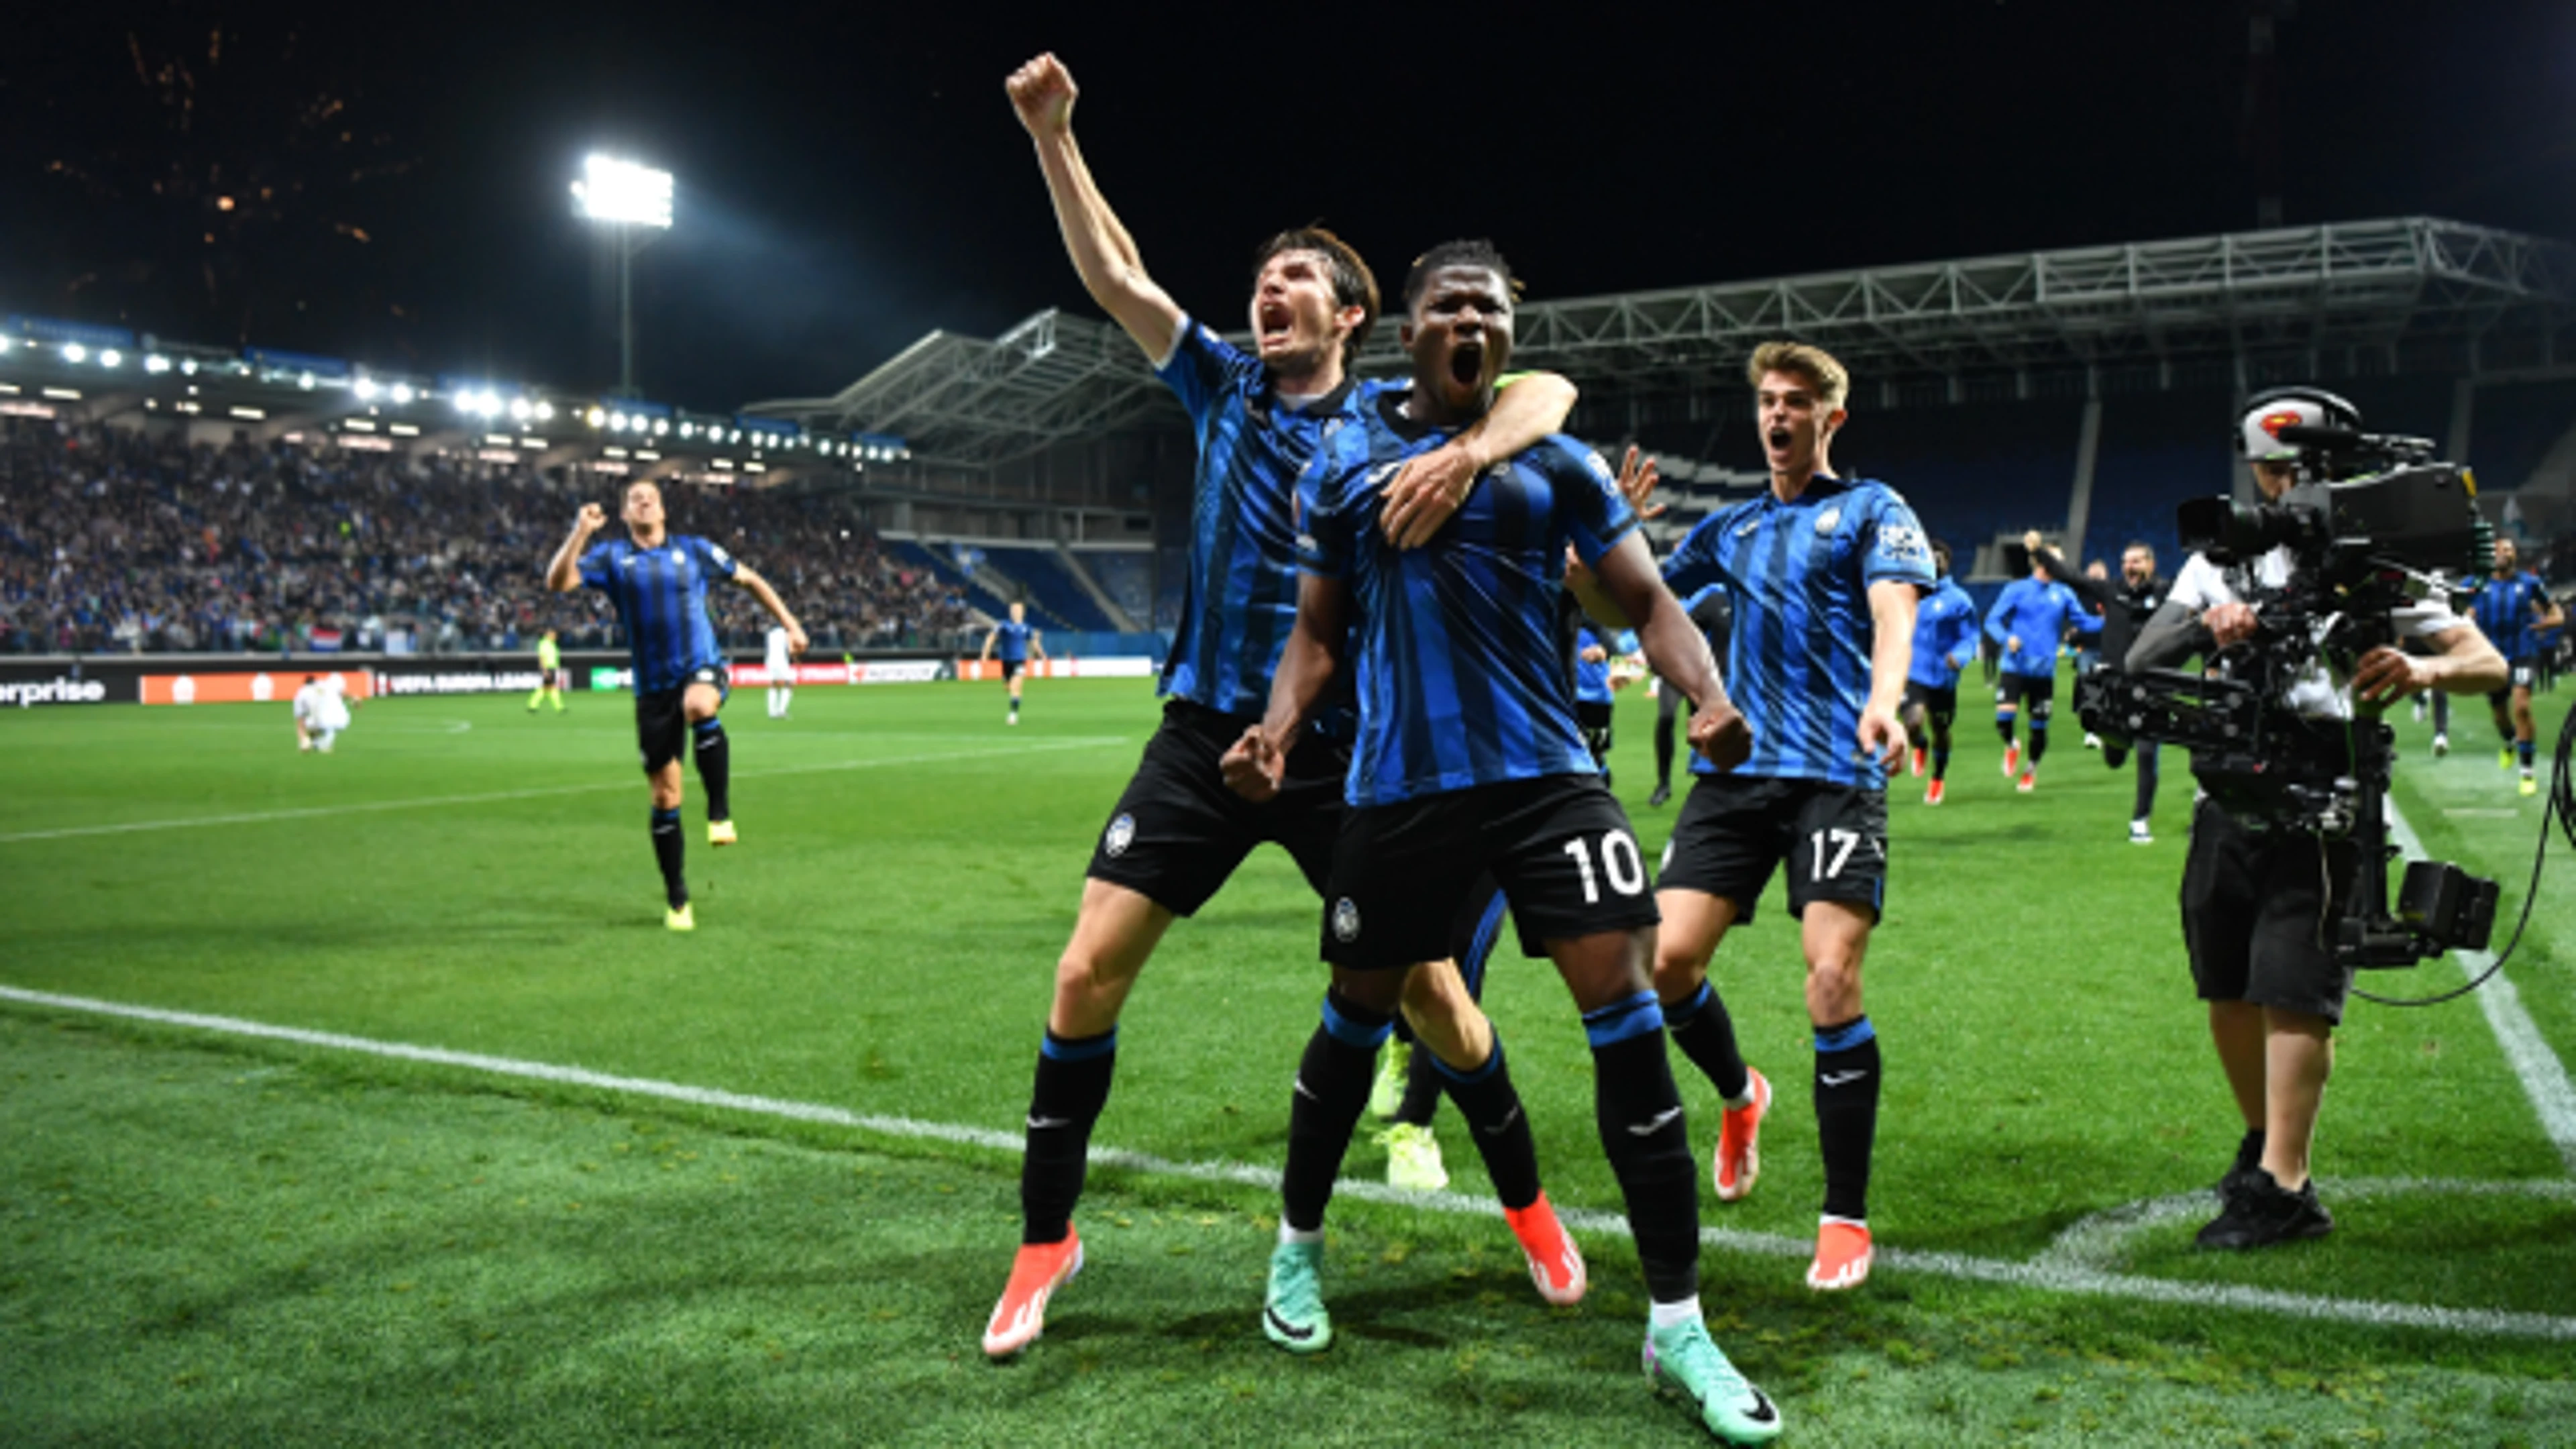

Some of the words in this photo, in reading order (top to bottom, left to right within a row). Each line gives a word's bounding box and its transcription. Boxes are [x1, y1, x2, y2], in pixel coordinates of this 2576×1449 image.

[390, 675, 431, 692] UEFA
[436, 674, 492, 690] EUROPA
[495, 672, 543, 690] LEAGU
[1564, 829, 1644, 903] 10
[1811, 828, 1860, 882] 17
